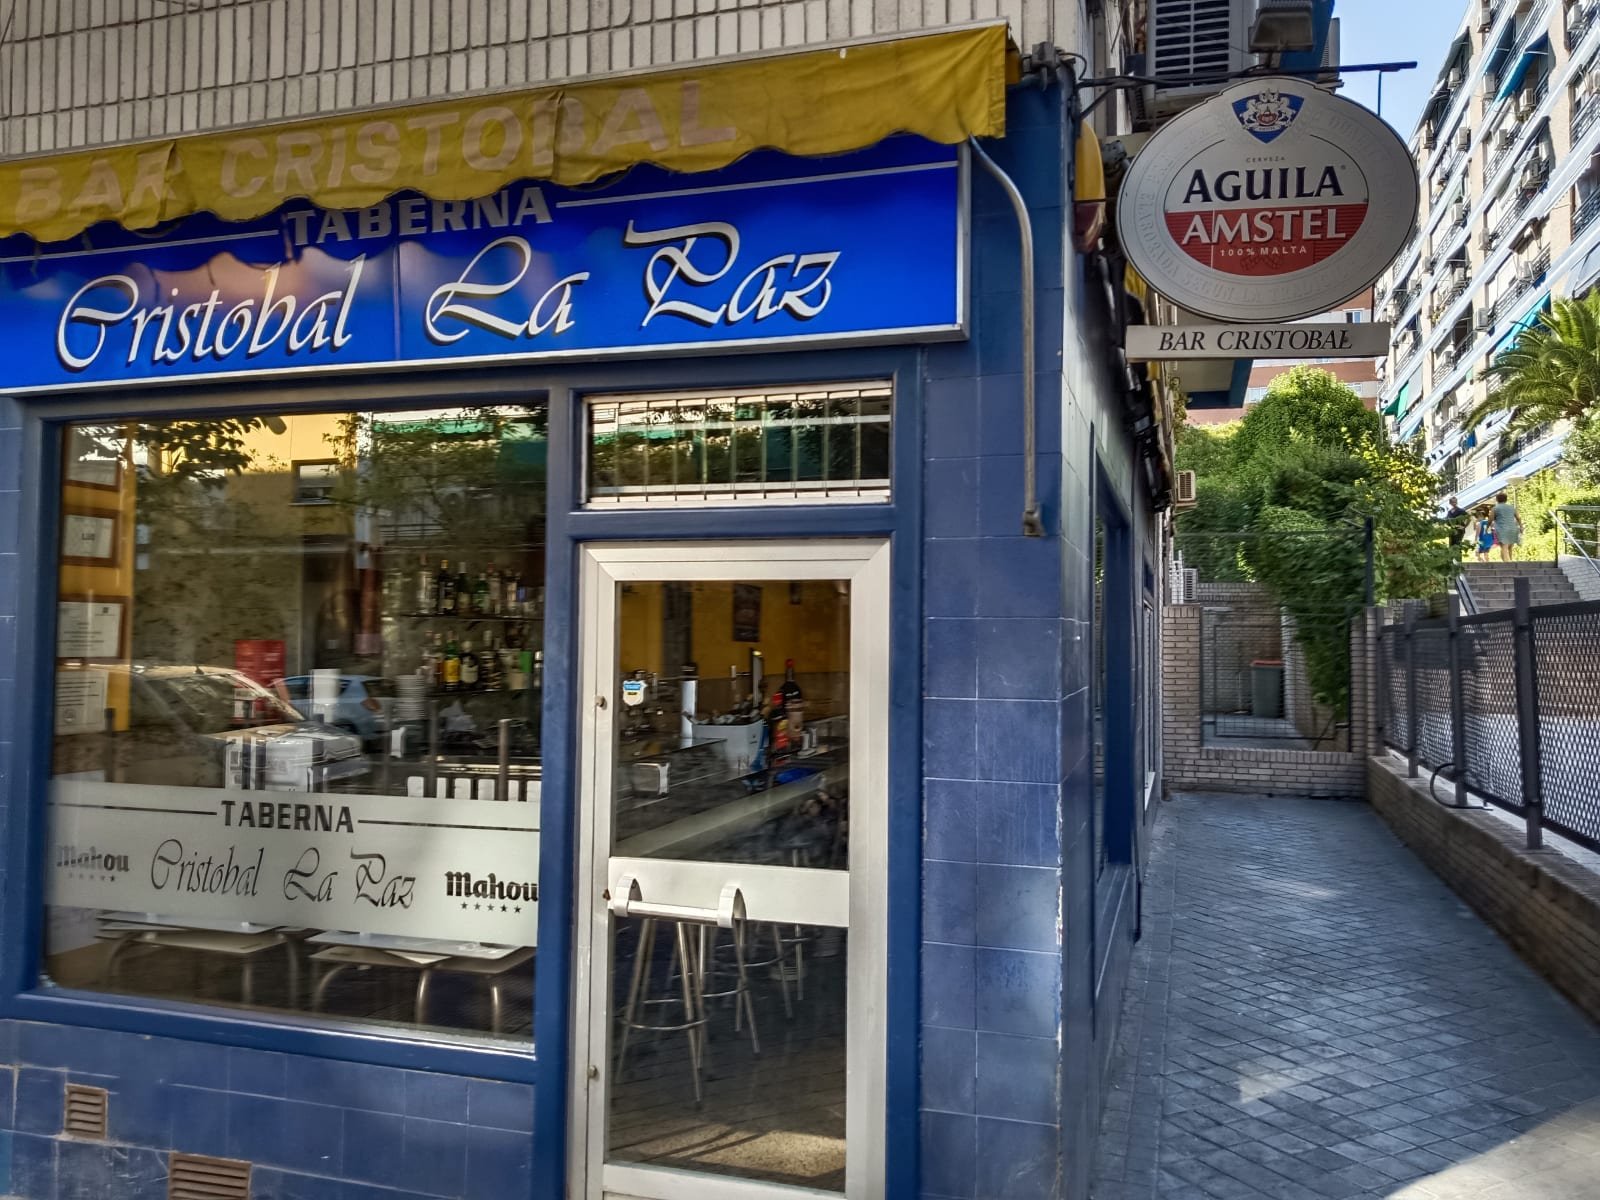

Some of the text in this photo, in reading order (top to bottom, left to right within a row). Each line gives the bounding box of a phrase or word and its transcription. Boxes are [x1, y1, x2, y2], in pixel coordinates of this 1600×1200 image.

[14, 80, 737, 224] BAR CRISTOBAL
[1246, 155, 1286, 163] CERVEZA
[1182, 165, 1344, 204] AGUILA
[287, 186, 553, 247] TABERNA
[1181, 207, 1346, 246] AMSTEL
[1220, 245, 1307, 257] 100% MALTA
[57, 218, 842, 371] Cristobal La Paz
[1158, 329, 1353, 351] BAR CRISTOBAL
[220, 799, 355, 834] TABERNA
[56, 845, 130, 873] Mahou
[151, 838, 417, 910] Cristobal La Paz
[445, 870, 539, 903] Mahou
